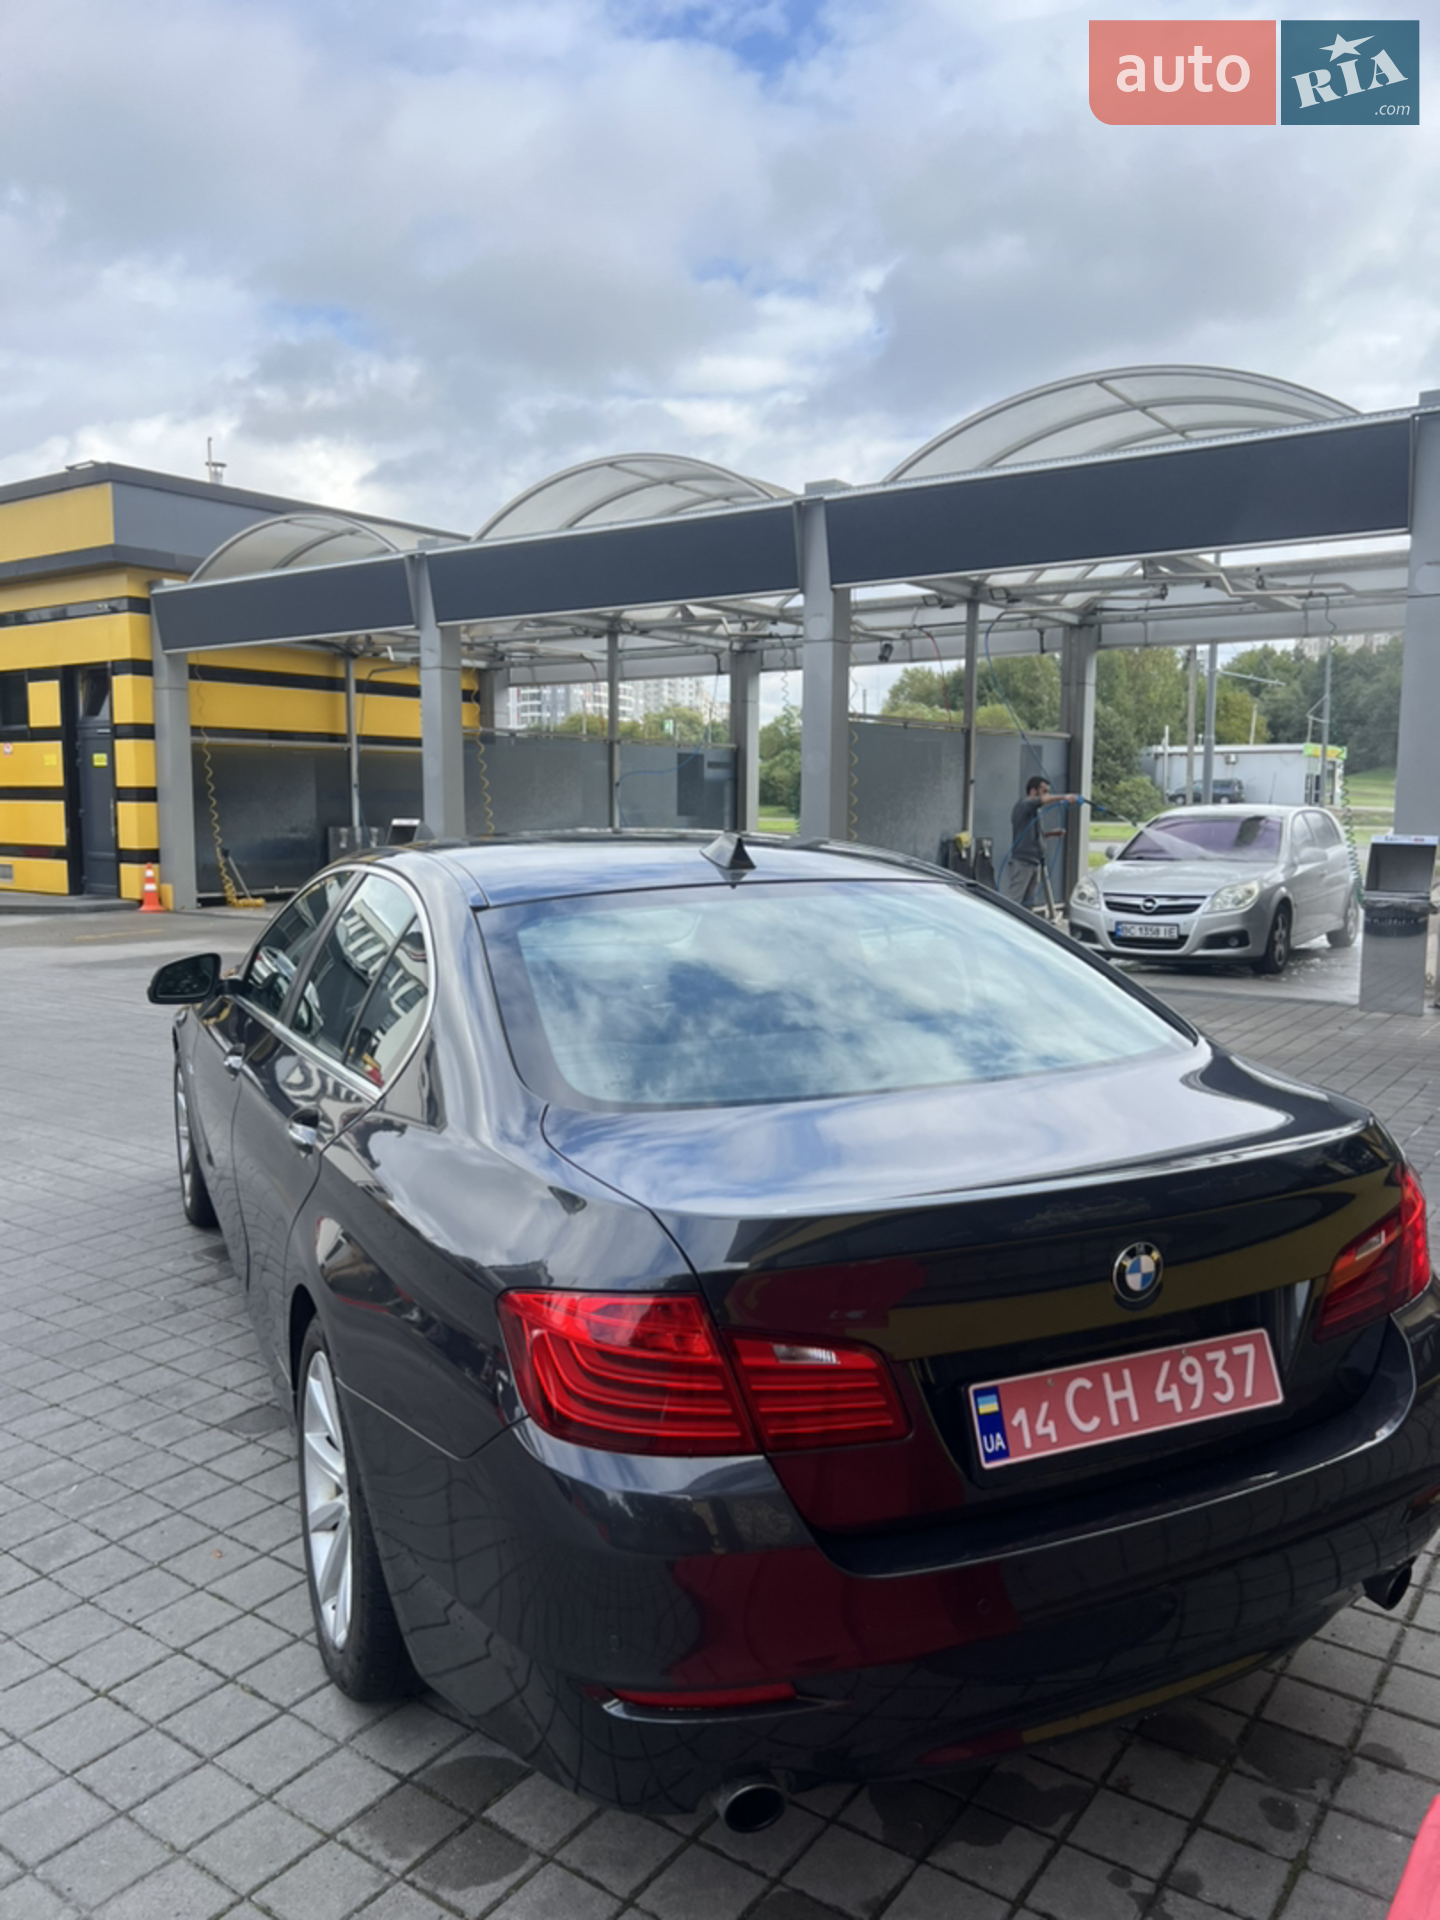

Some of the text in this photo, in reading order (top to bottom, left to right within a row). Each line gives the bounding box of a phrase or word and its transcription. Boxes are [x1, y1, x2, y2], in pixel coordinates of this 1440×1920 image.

[1011, 1343, 1256, 1450] 14 CH 4937
[982, 1432, 1007, 1454] UA
